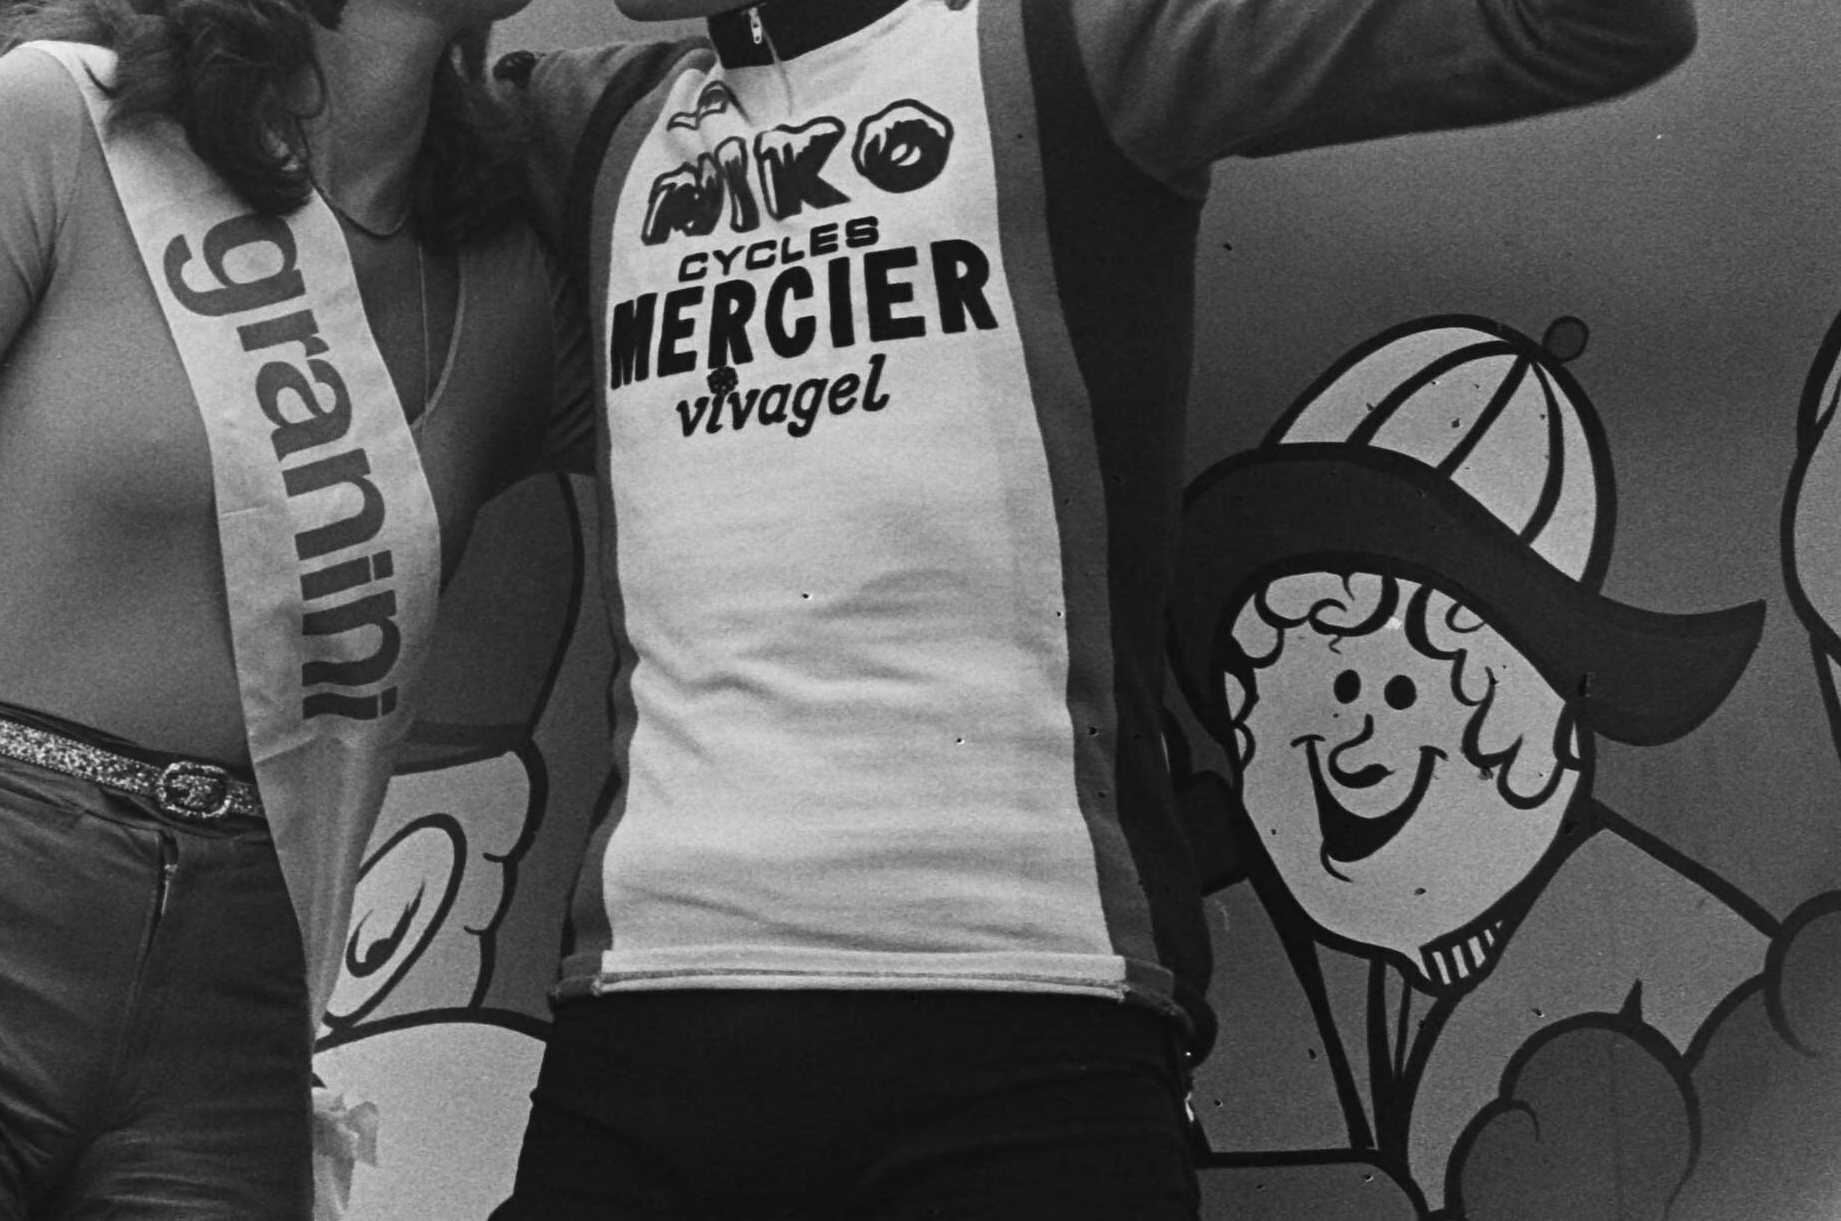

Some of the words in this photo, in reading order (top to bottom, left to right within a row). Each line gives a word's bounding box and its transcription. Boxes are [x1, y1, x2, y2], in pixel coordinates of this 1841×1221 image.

[677, 215, 880, 282] CYCLES
[610, 238, 999, 390] MERCIER
[675, 353, 890, 438] vivagel
[162, 212, 403, 722] granini
